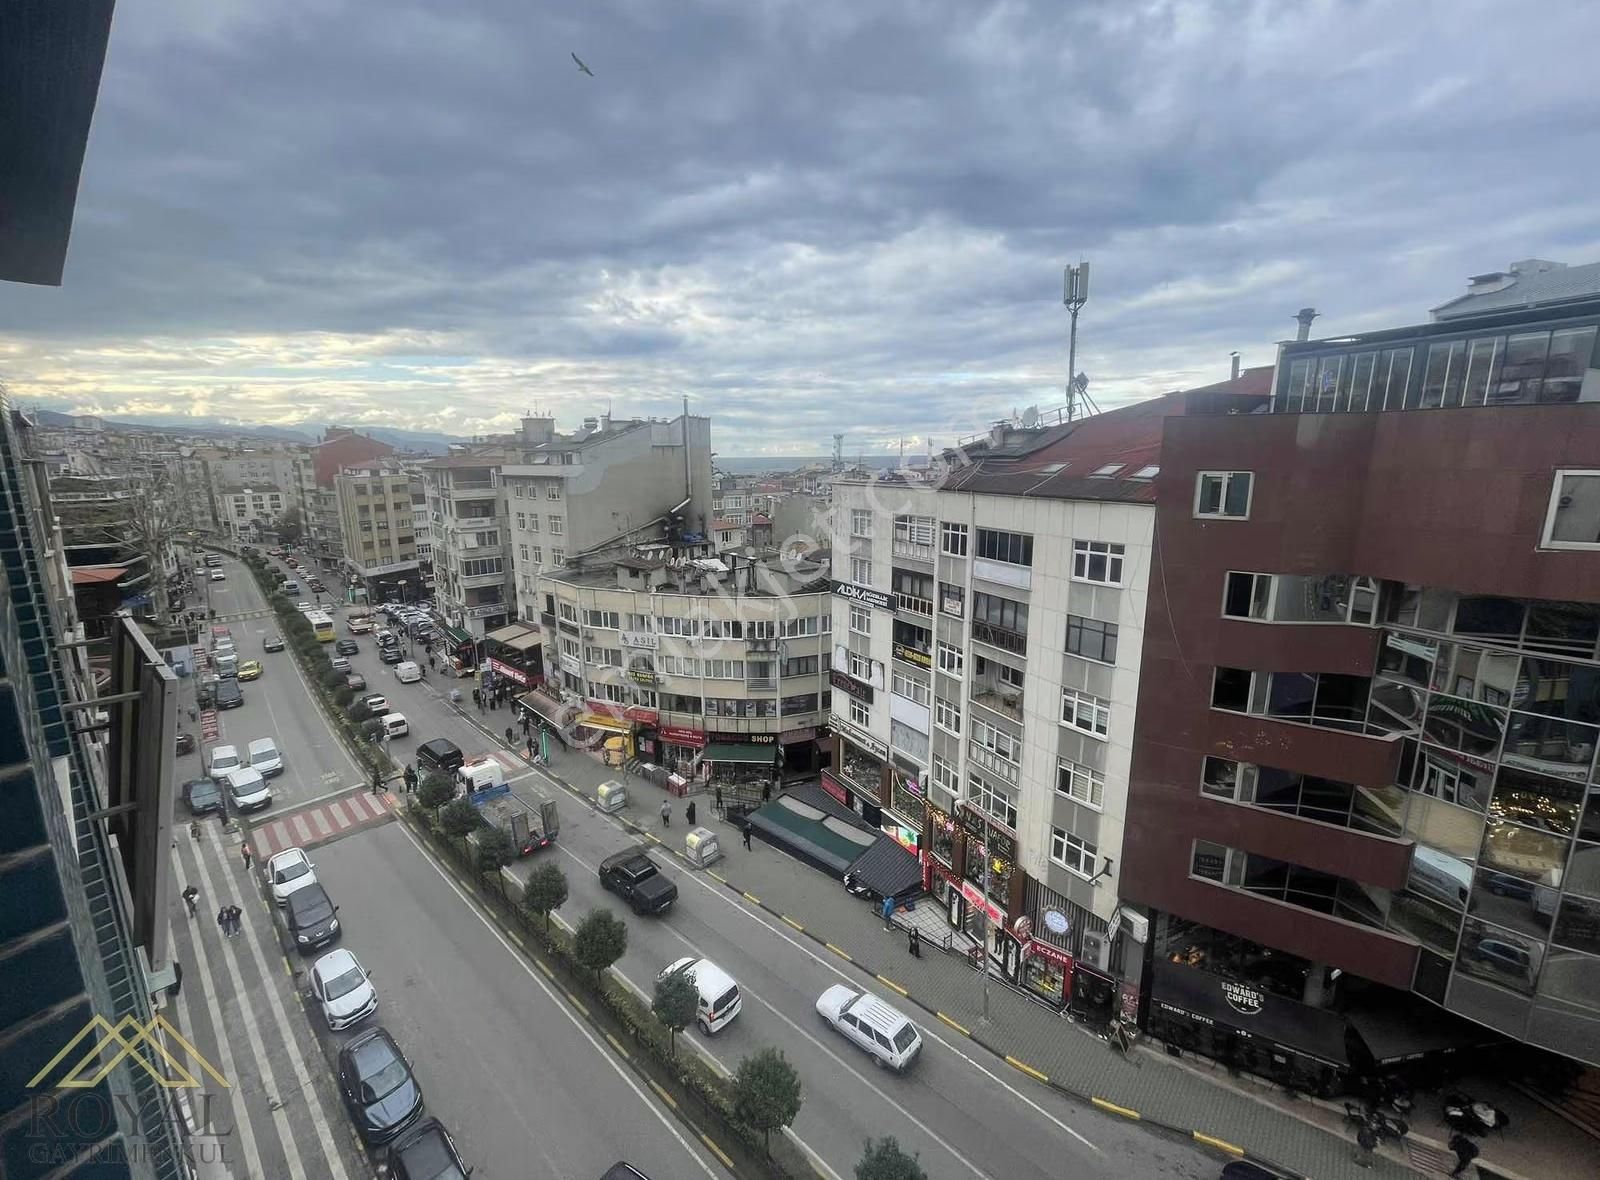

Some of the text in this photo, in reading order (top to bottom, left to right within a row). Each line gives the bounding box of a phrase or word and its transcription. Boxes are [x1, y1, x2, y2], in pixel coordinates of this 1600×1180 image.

[751, 735, 774, 744] SHOP
[1036, 945, 1067, 963] ECZANE
[1221, 981, 1265, 1002] EDWARD'S
[1227, 991, 1260, 1008] COFFEE
[1191, 1013, 1214, 1025] COFFEE
